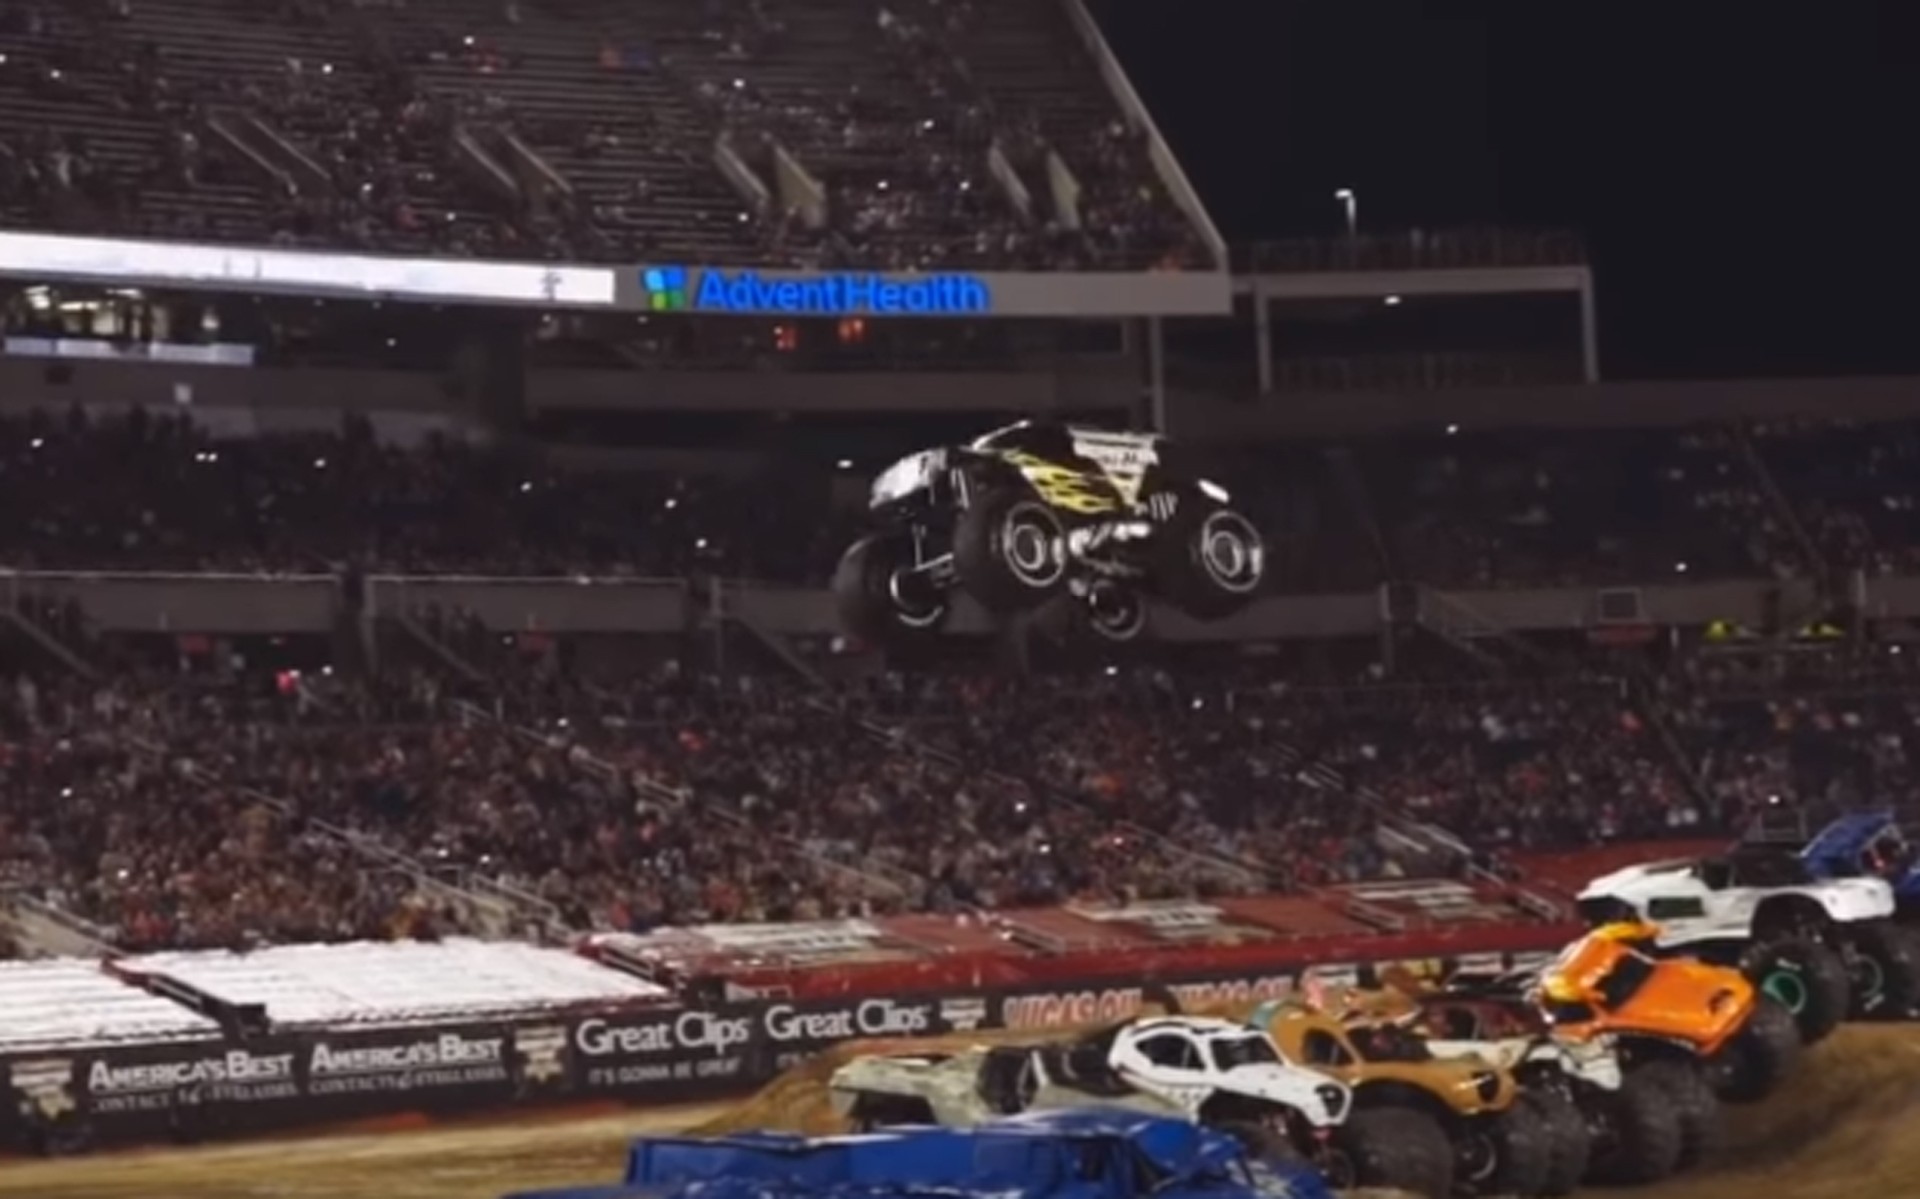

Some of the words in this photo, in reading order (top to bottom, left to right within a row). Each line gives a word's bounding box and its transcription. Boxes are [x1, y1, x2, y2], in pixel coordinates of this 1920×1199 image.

[697, 269, 989, 314] AdventHealth
[576, 1019, 672, 1054] Great
[674, 1010, 752, 1056] Clips
[764, 1004, 853, 1041] Great
[857, 998, 928, 1034] Clips
[673, 1061, 693, 1079] BE
